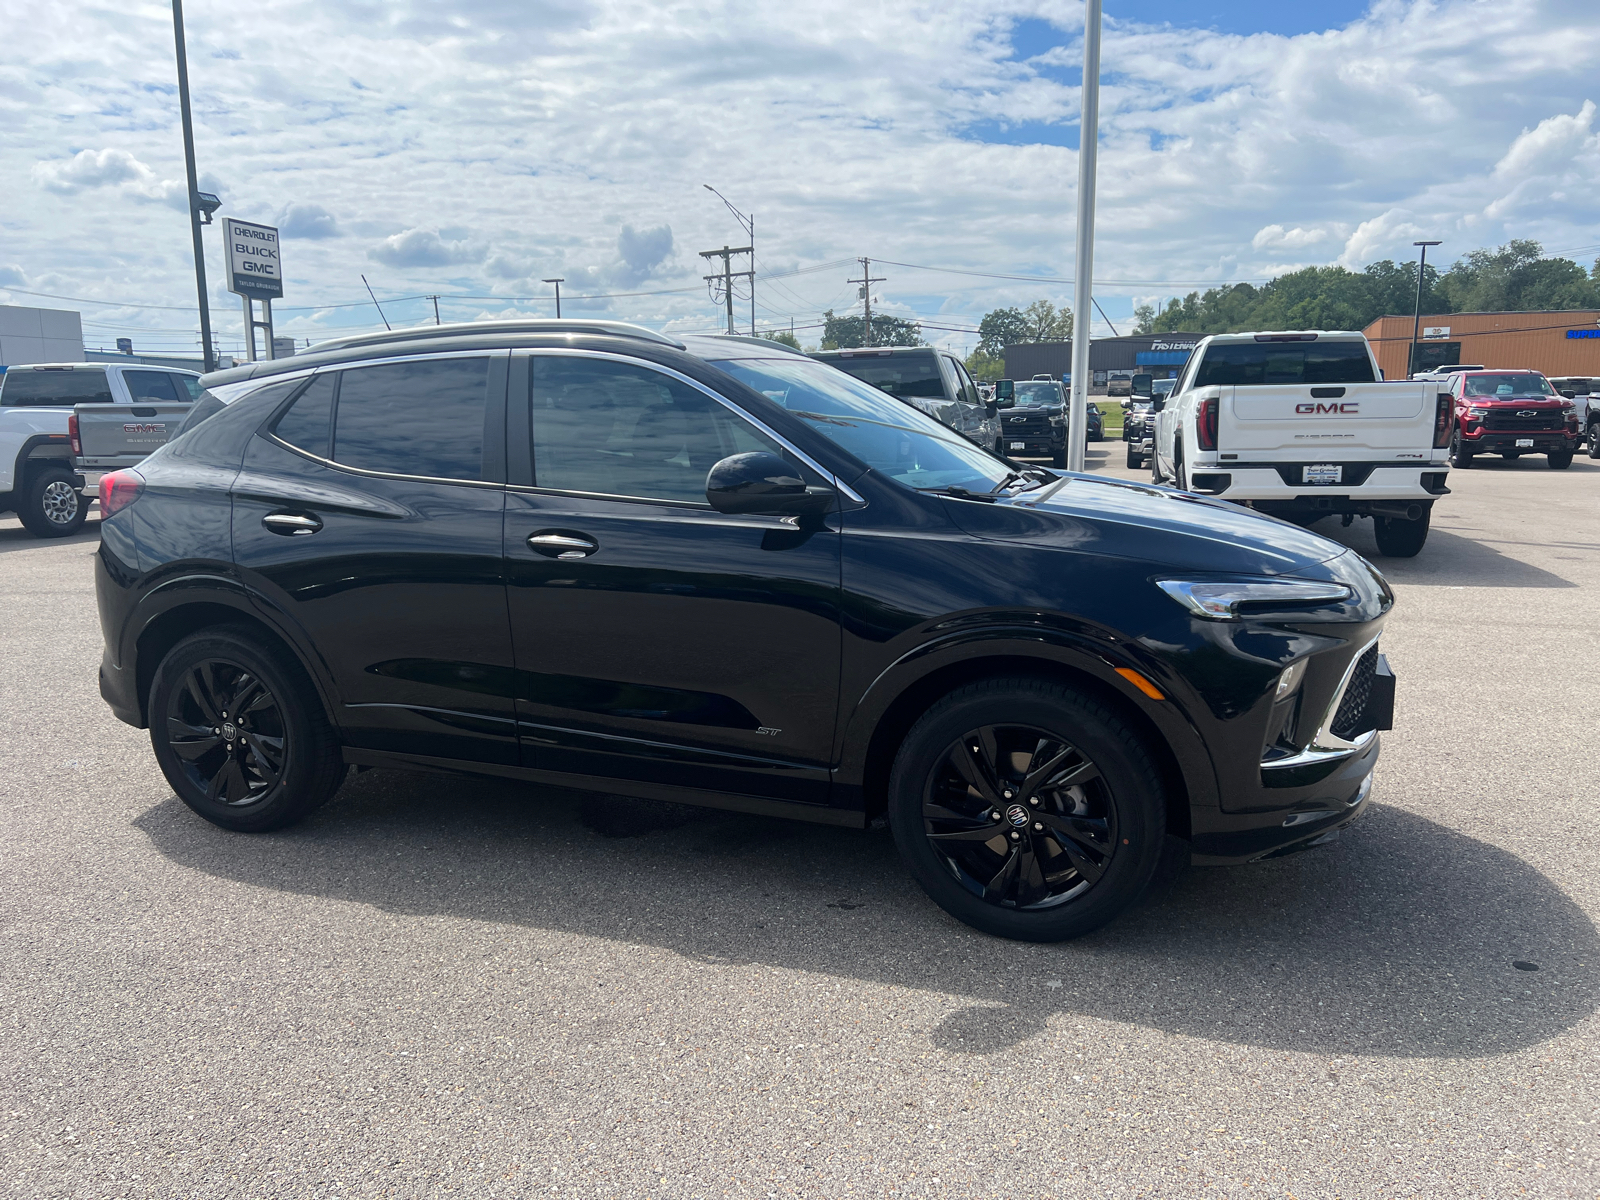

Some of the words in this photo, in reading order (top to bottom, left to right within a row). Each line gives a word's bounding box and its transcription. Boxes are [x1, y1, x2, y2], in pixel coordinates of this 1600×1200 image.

[234, 227, 276, 242] CHEVROLET
[235, 243, 277, 259] BUICK
[243, 261, 274, 275] GMC
[1566, 329, 1600, 339] SUPER
[1295, 403, 1359, 414] GMC
[123, 423, 167, 433] GMC
[755, 726, 782, 736] ST
